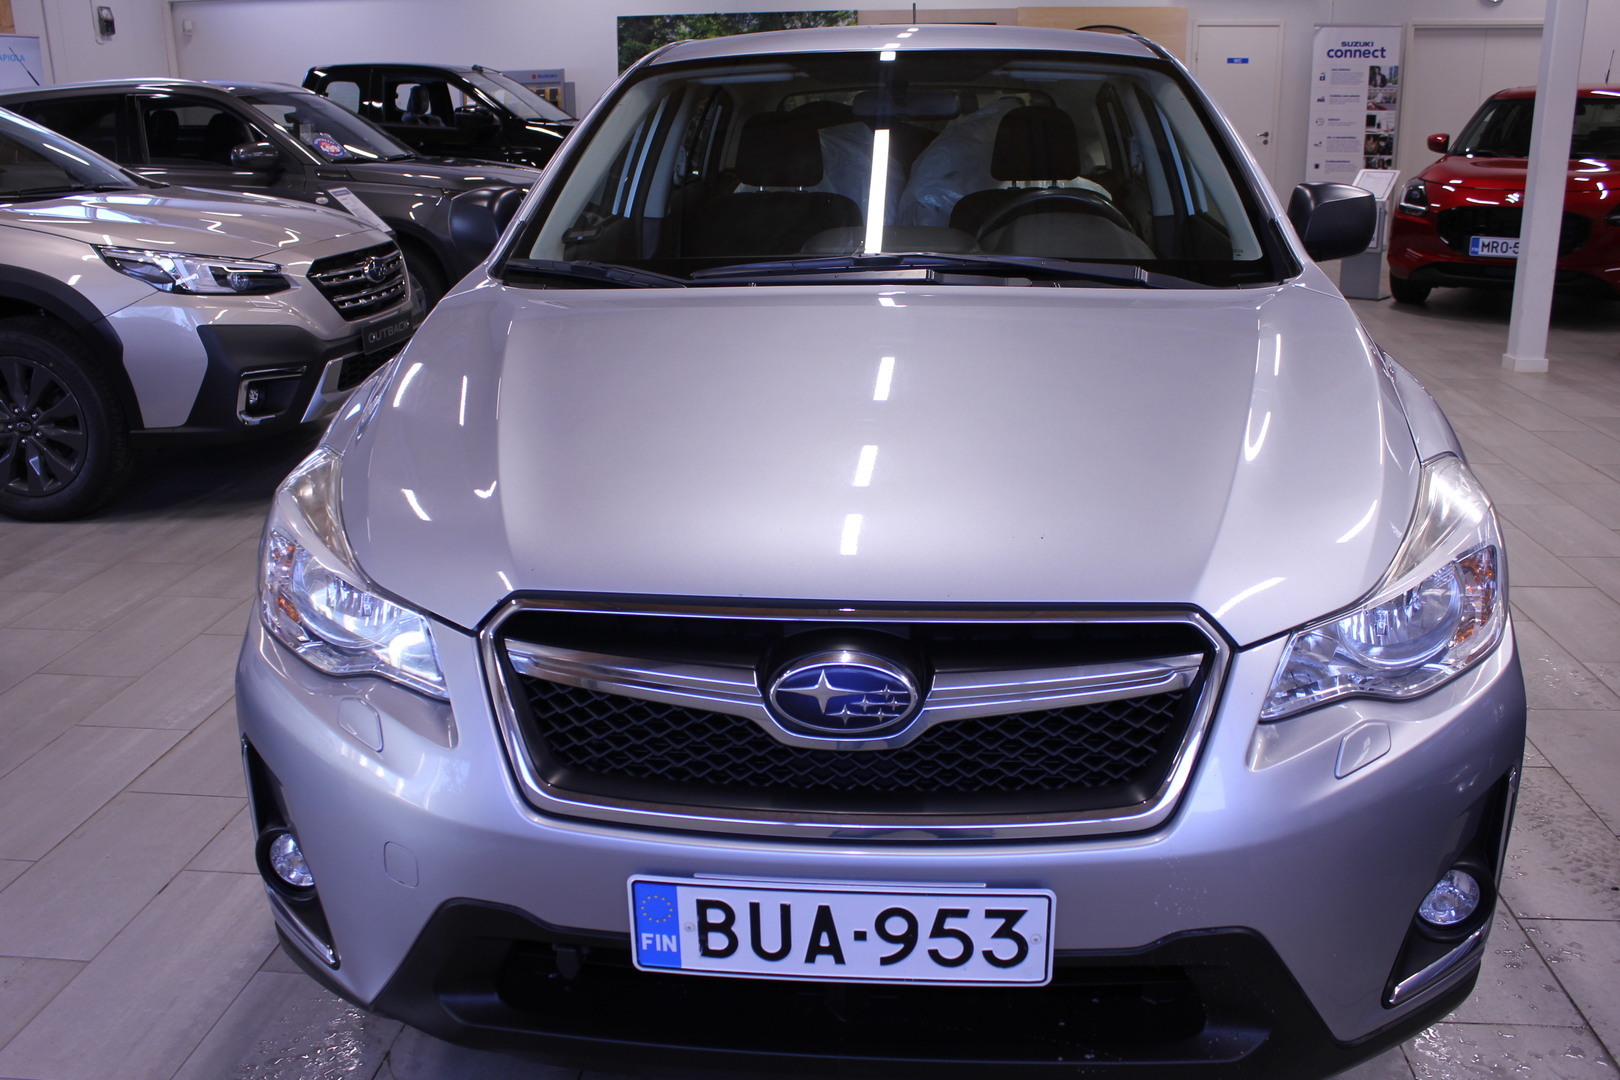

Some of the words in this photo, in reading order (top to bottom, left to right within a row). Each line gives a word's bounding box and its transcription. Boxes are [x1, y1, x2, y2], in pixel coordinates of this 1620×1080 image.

[1327, 47, 1386, 58] connect
[369, 320, 409, 343] OUTBACK
[641, 932, 678, 953] FIN
[696, 898, 1029, 969] BUA-953
